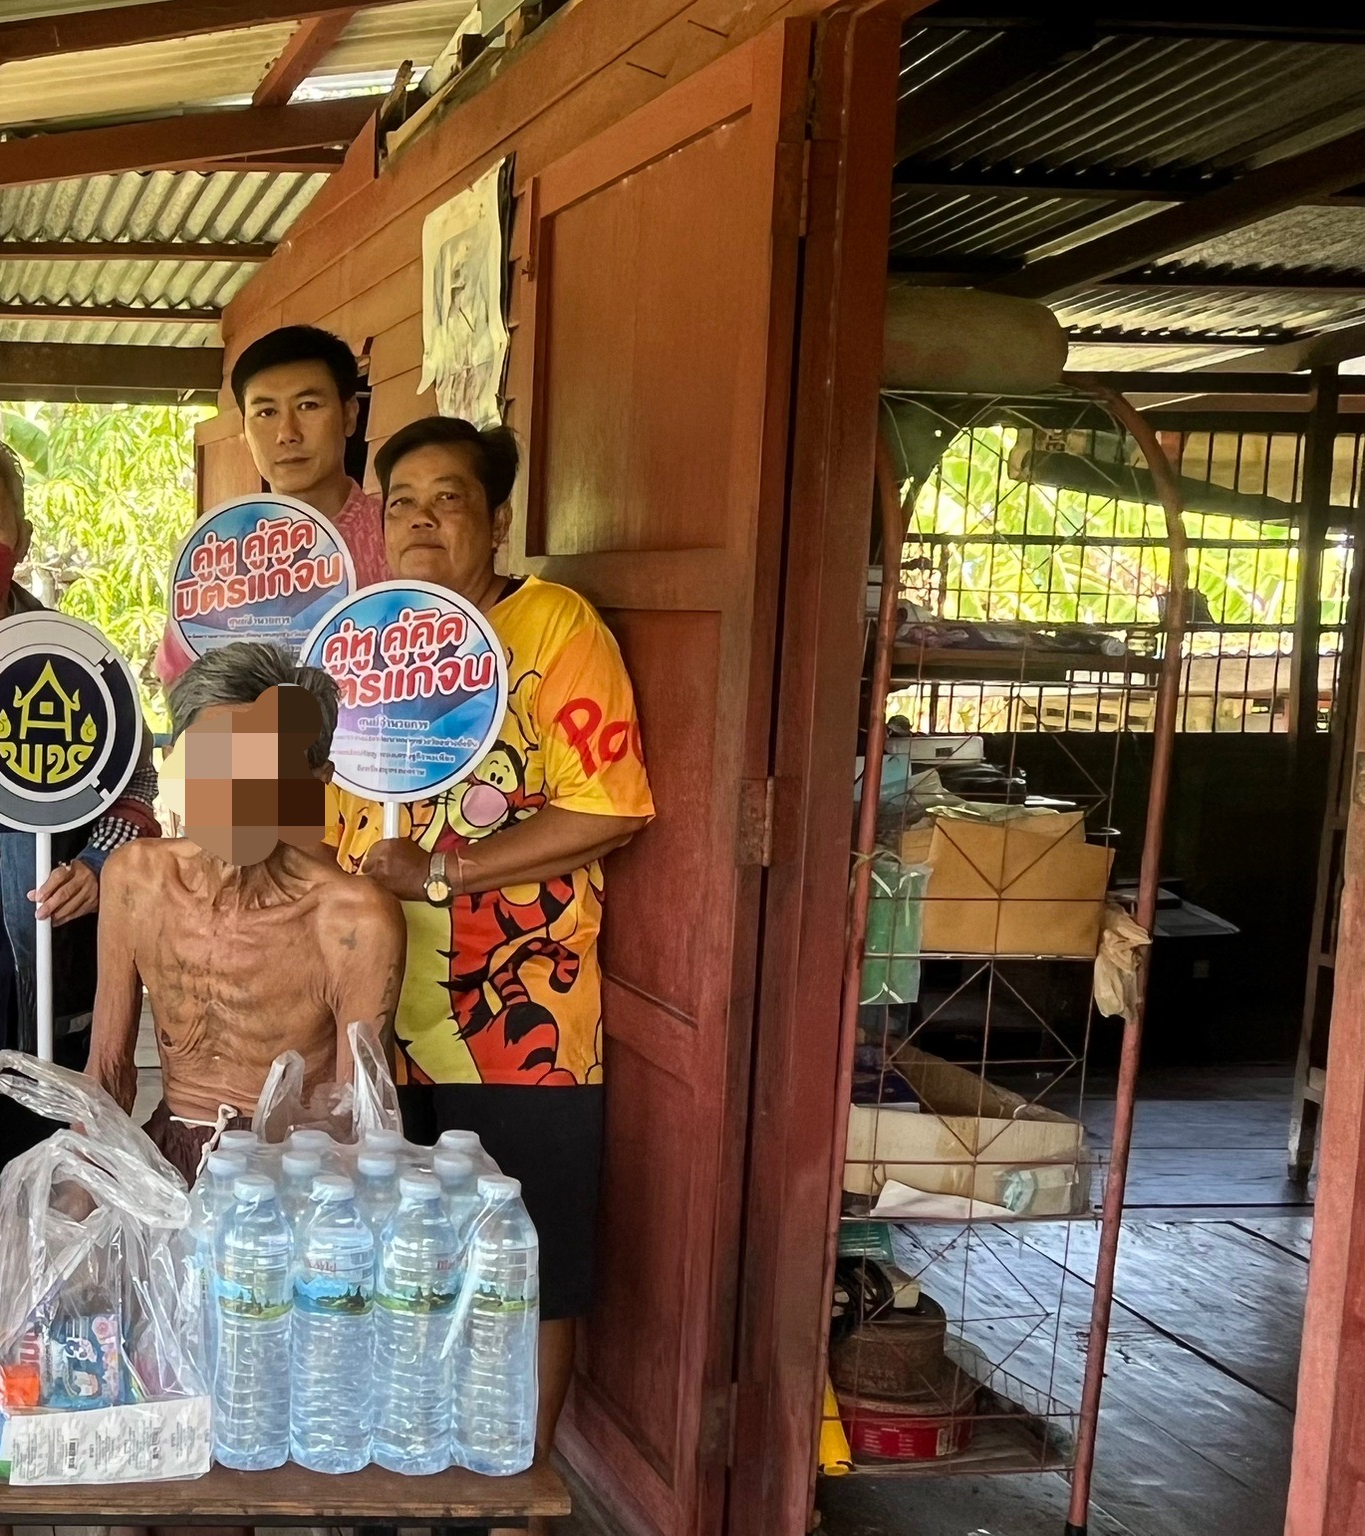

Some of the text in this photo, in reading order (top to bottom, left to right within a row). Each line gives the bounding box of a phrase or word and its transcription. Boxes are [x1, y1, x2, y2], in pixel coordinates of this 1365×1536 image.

[192, 520, 314, 582] คู่หู คู่คิด
[176, 553, 341, 618] มิตรแก้จน
[324, 610, 463, 675] คู่หู คู่คิด
[335, 650, 492, 706] ตรแก้จน
